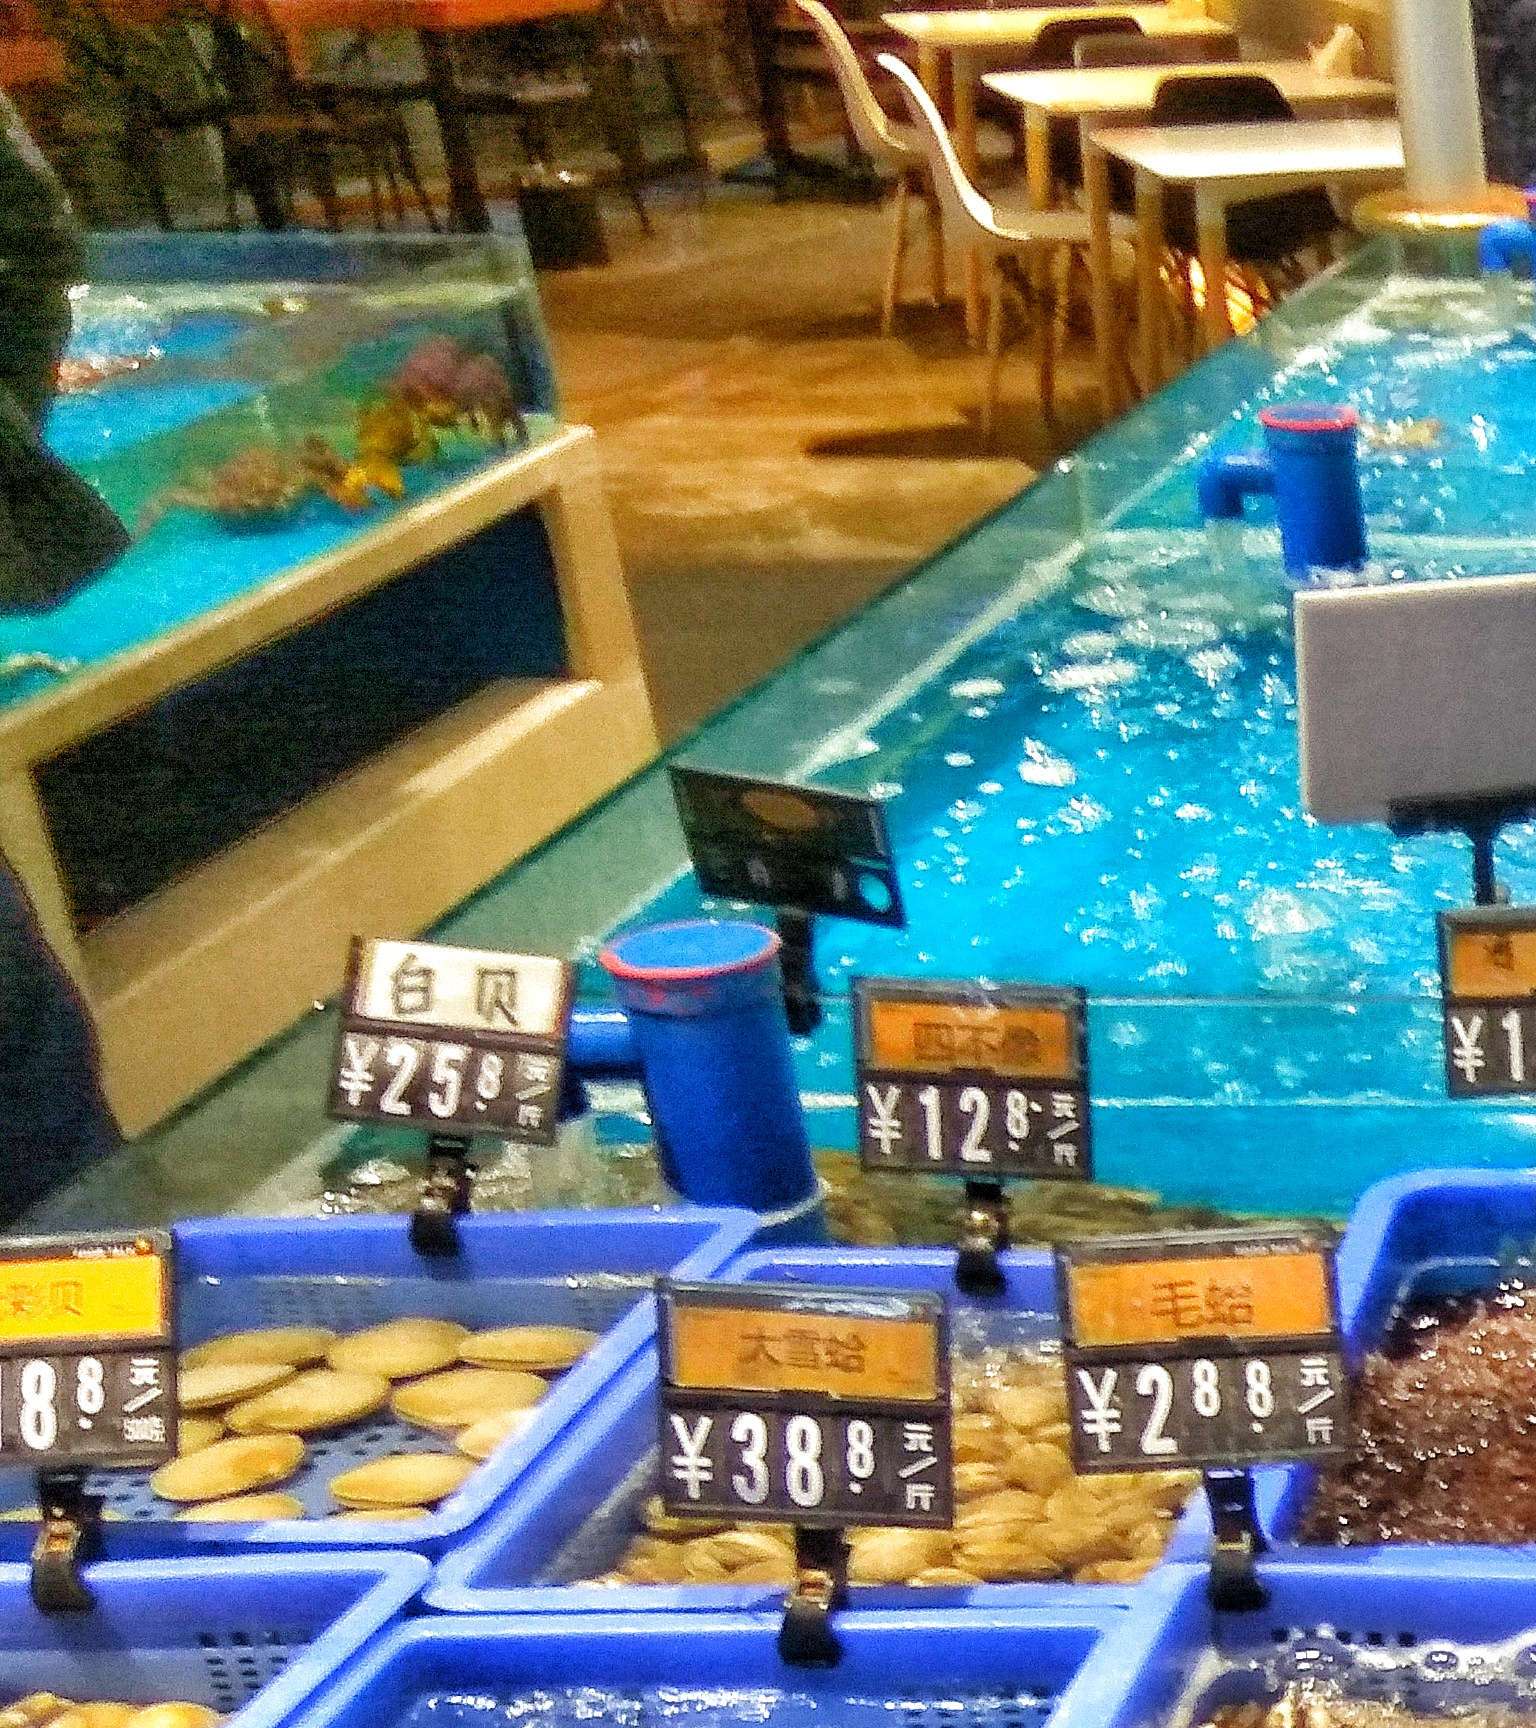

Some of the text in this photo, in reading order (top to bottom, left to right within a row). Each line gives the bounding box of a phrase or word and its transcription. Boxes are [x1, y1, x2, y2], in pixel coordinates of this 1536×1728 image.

[391, 952, 519, 1026] 白贝
[0, 1280, 83, 1317] 彩贝
[1150, 1279, 1254, 1328] 毛蛤
